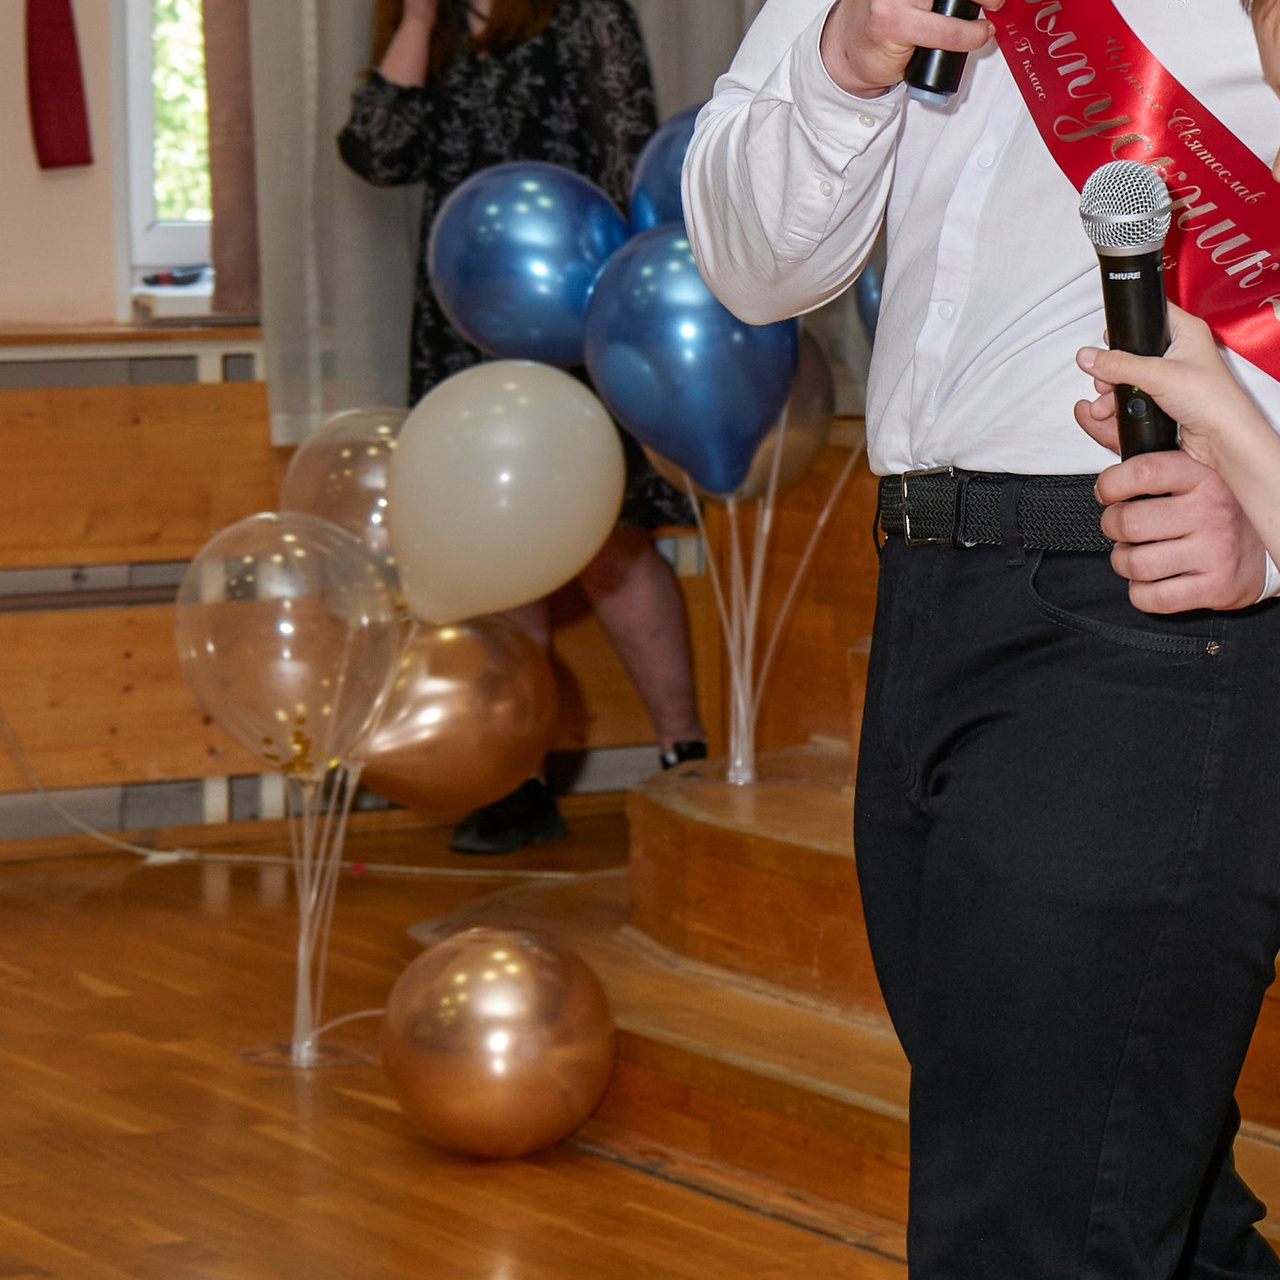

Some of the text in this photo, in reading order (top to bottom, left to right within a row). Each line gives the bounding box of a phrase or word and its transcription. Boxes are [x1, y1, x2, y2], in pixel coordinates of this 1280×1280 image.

[1022, 59, 1047, 101] класс
[1167, 108, 1267, 205] Святослав
[1109, 271, 1141, 281] SHURE
